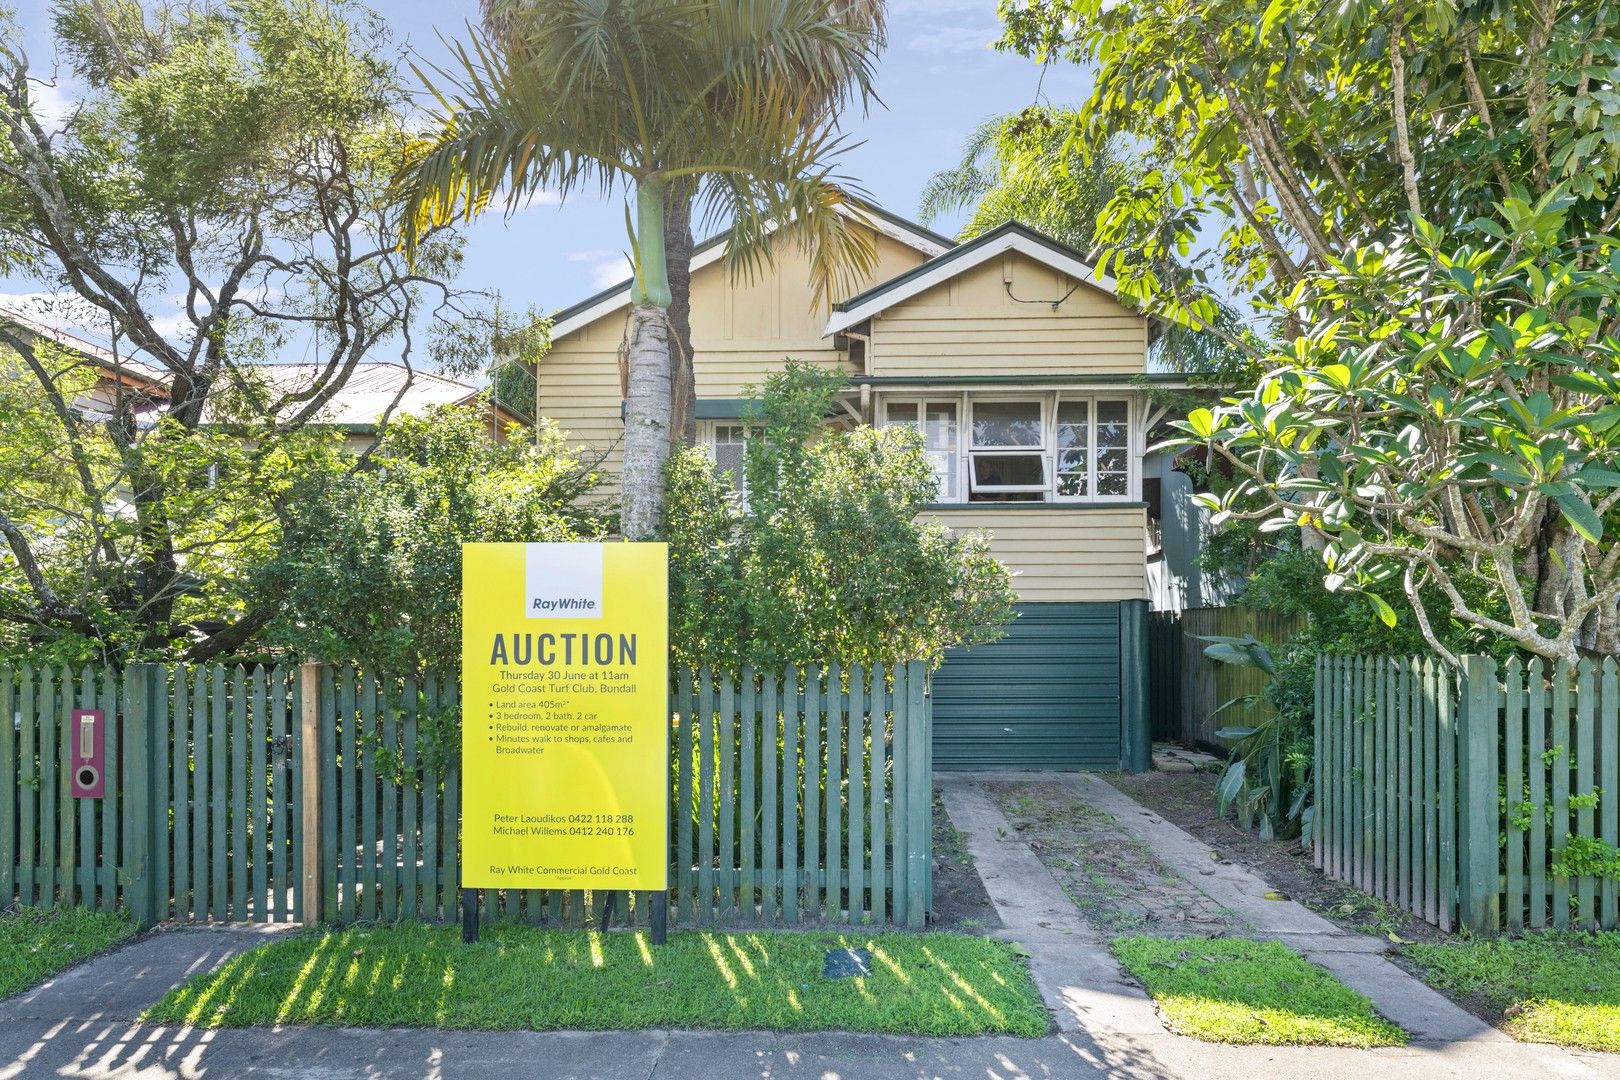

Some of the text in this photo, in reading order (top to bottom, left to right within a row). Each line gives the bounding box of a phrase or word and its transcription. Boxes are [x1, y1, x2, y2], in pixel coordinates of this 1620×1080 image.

[533, 598, 595, 611] RayWhite
[490, 633, 636, 666] AUCTION
[500, 671, 629, 683] Thursday 30 June at 11am
[492, 683, 636, 694] Gold Coast Turf Club, Bundall
[496, 701, 516, 709] Land
[496, 712, 502, 720] 3
[504, 712, 544, 721] bedroom,
[546, 712, 551, 720] 2
[553, 712, 574, 721] bath,
[577, 712, 582, 720] 2
[496, 723, 529, 732] Rebuild,
[531, 724, 568, 732] renovate
[581, 723, 632, 733] amalgamate
[496, 735, 530, 743] Minutes
[532, 735, 551, 743] walk
[565, 735, 591, 744] shops,
[593, 735, 615, 743] cafes
[617, 735, 633, 743] and
[496, 746, 544, 754] Broadwater
[494, 814, 634, 824] Peter Laoudikos 0422 118 288
[493, 826, 635, 836] Michael Willems 0412 240 176
[490, 866, 637, 876] Ray White Commercial Gold Coast
